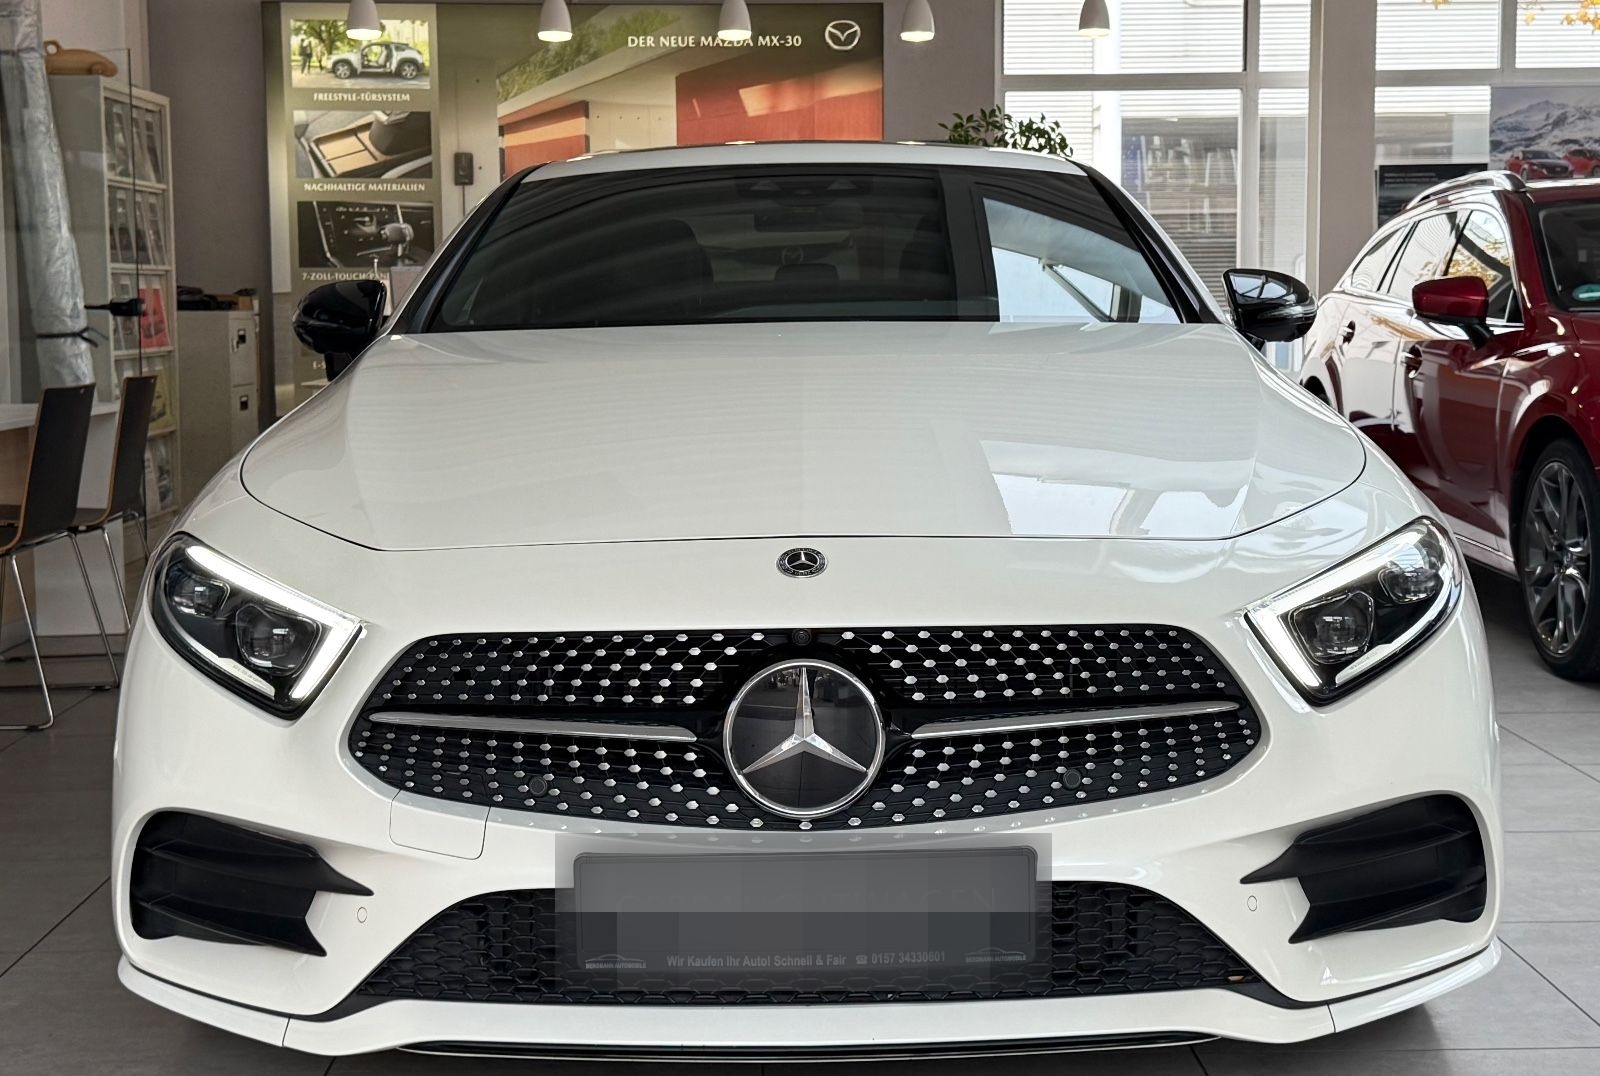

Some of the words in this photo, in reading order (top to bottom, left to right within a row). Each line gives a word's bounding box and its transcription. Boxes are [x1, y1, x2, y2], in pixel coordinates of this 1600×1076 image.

[627, 35, 656, 48] DER
[659, 35, 696, 48] NEUE
[700, 35, 754, 48] MAZDA
[757, 35, 802, 47] MX-30
[313, 91, 411, 102] FREESTYLE-TÜRSYSTEM
[303, 182, 366, 192] NACHHALTIGE
[368, 182, 426, 192] MATERIALIEN
[666, 955, 685, 967] Wir
[687, 955, 724, 967] Kaufen
[726, 955, 741, 967] Ihr
[773, 954, 813, 967] Schnell
[815, 955, 824, 966] &
[826, 954, 847, 966] Fair
[871, 952, 896, 964] 0157
[898, 951, 946, 963] 34330601
